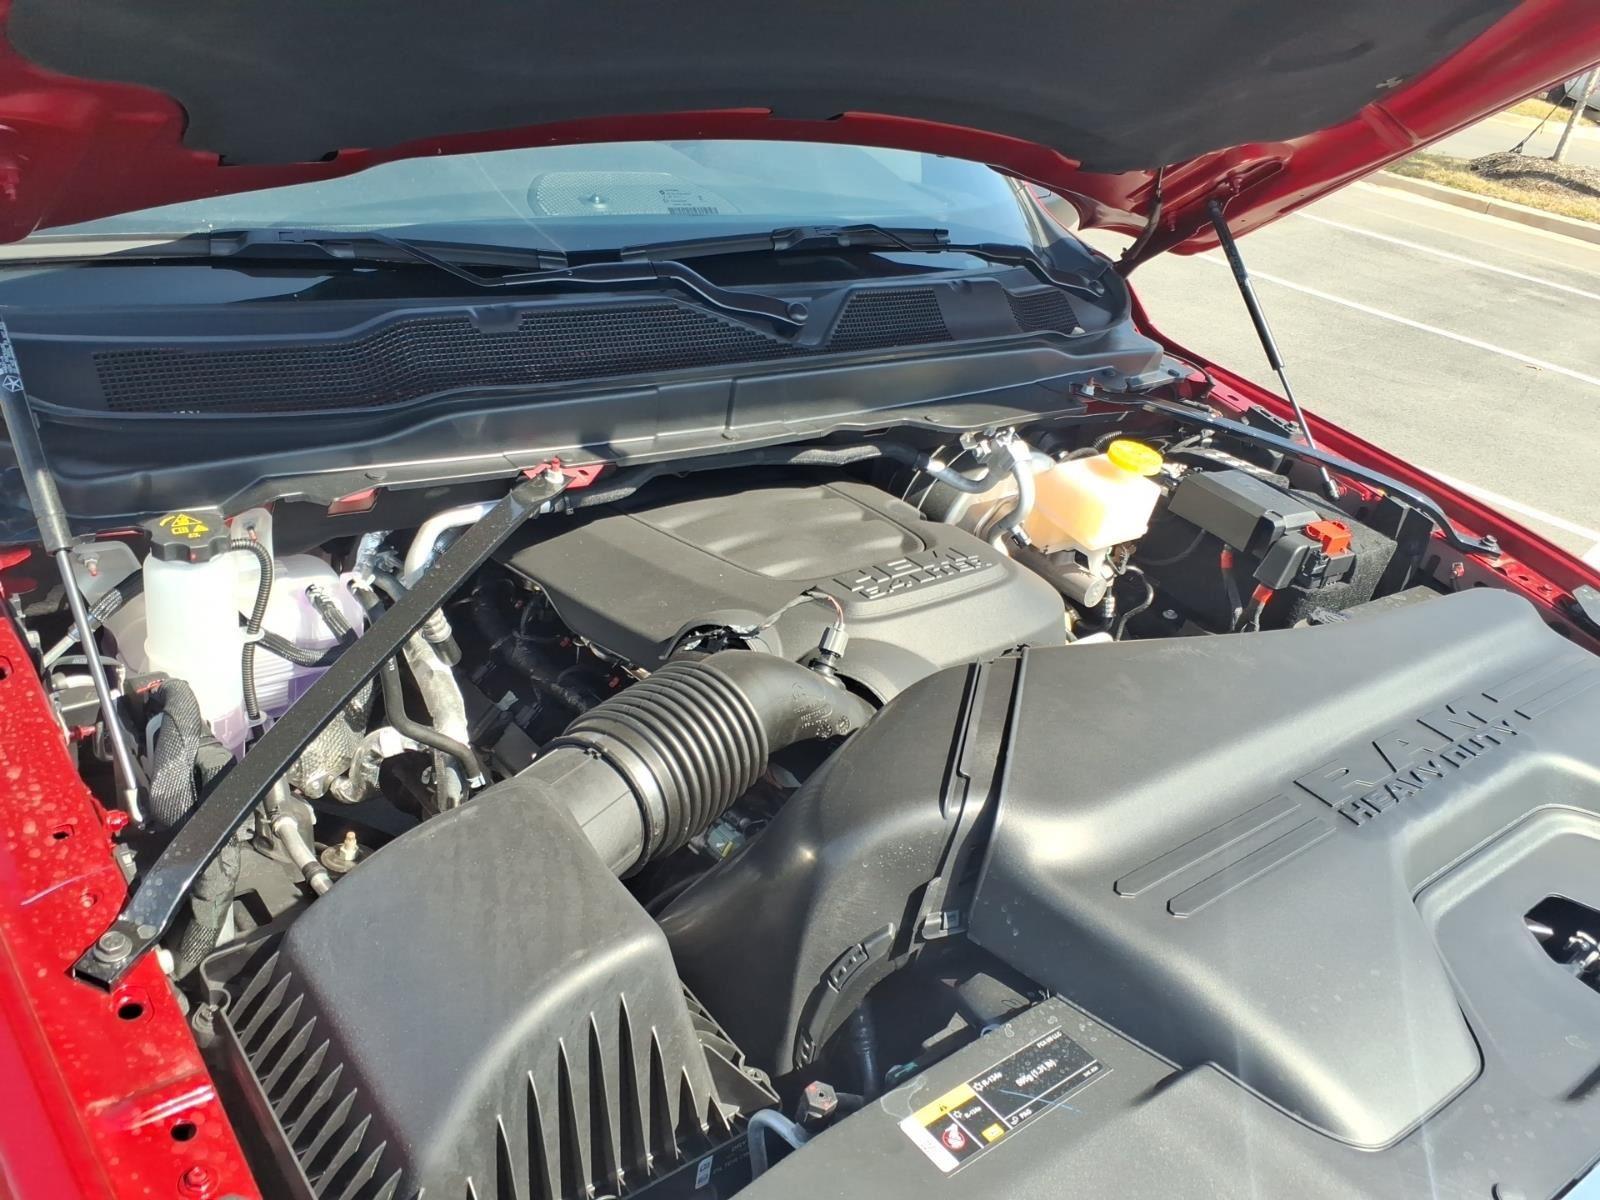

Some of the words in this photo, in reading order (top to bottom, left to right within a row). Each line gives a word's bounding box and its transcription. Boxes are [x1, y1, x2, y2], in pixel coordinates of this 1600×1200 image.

[832, 547, 979, 592] HEMI
[908, 557, 993, 584] LITER
[1293, 695, 1501, 808] RAM
[1338, 757, 1444, 826] HEAVY
[1439, 718, 1519, 768] DUTY
